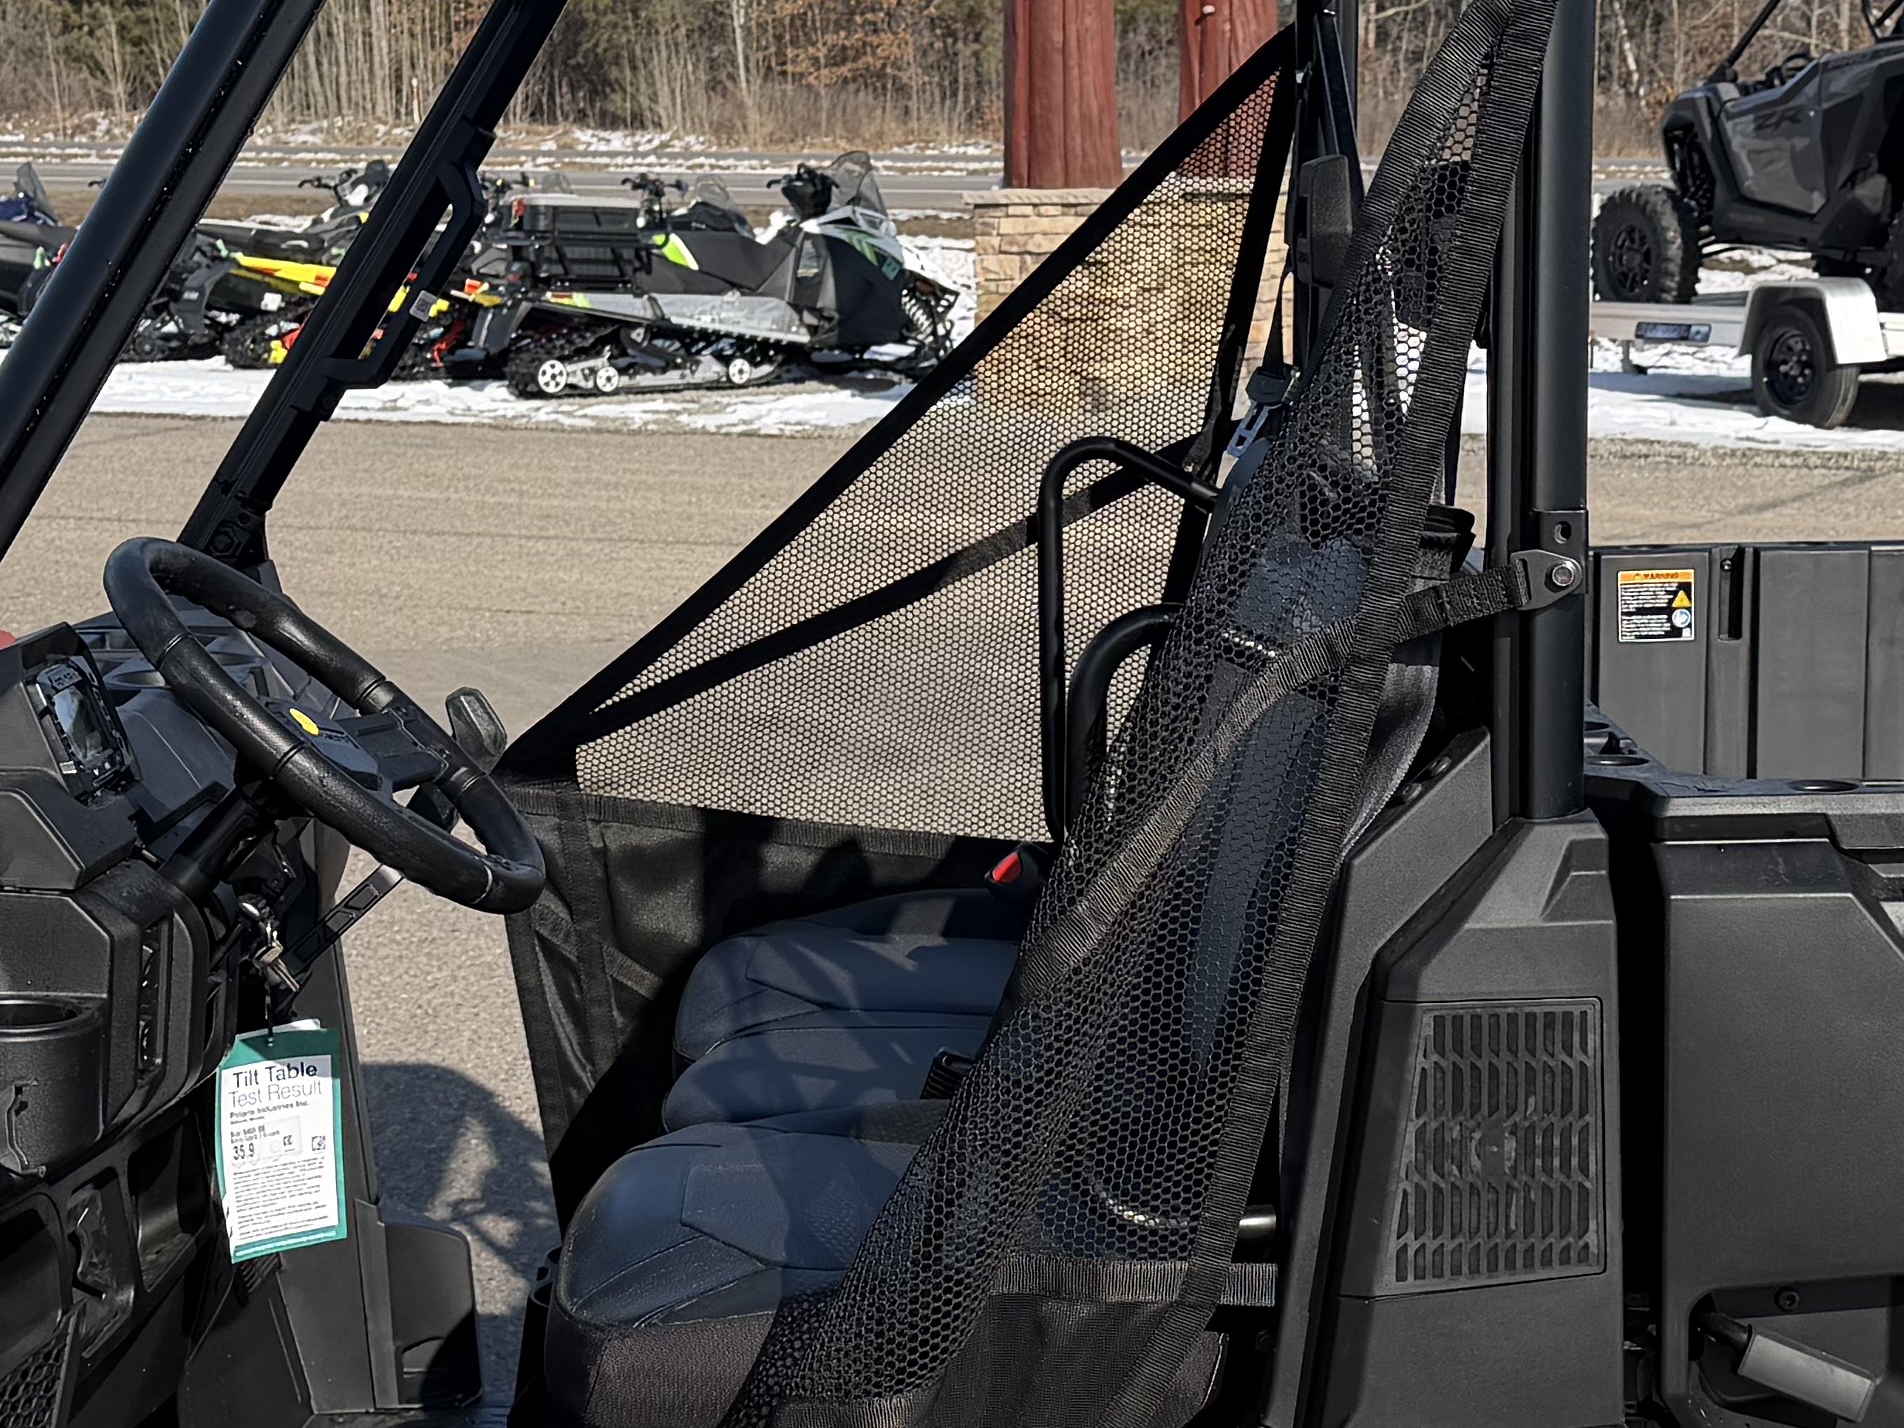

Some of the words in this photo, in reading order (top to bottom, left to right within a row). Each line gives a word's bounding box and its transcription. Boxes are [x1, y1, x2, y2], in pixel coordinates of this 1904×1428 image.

[232, 1069, 260, 1089] Tilt
[264, 1061, 318, 1083] Table
[228, 1088, 263, 1108] Test
[267, 1080, 322, 1102] Result
